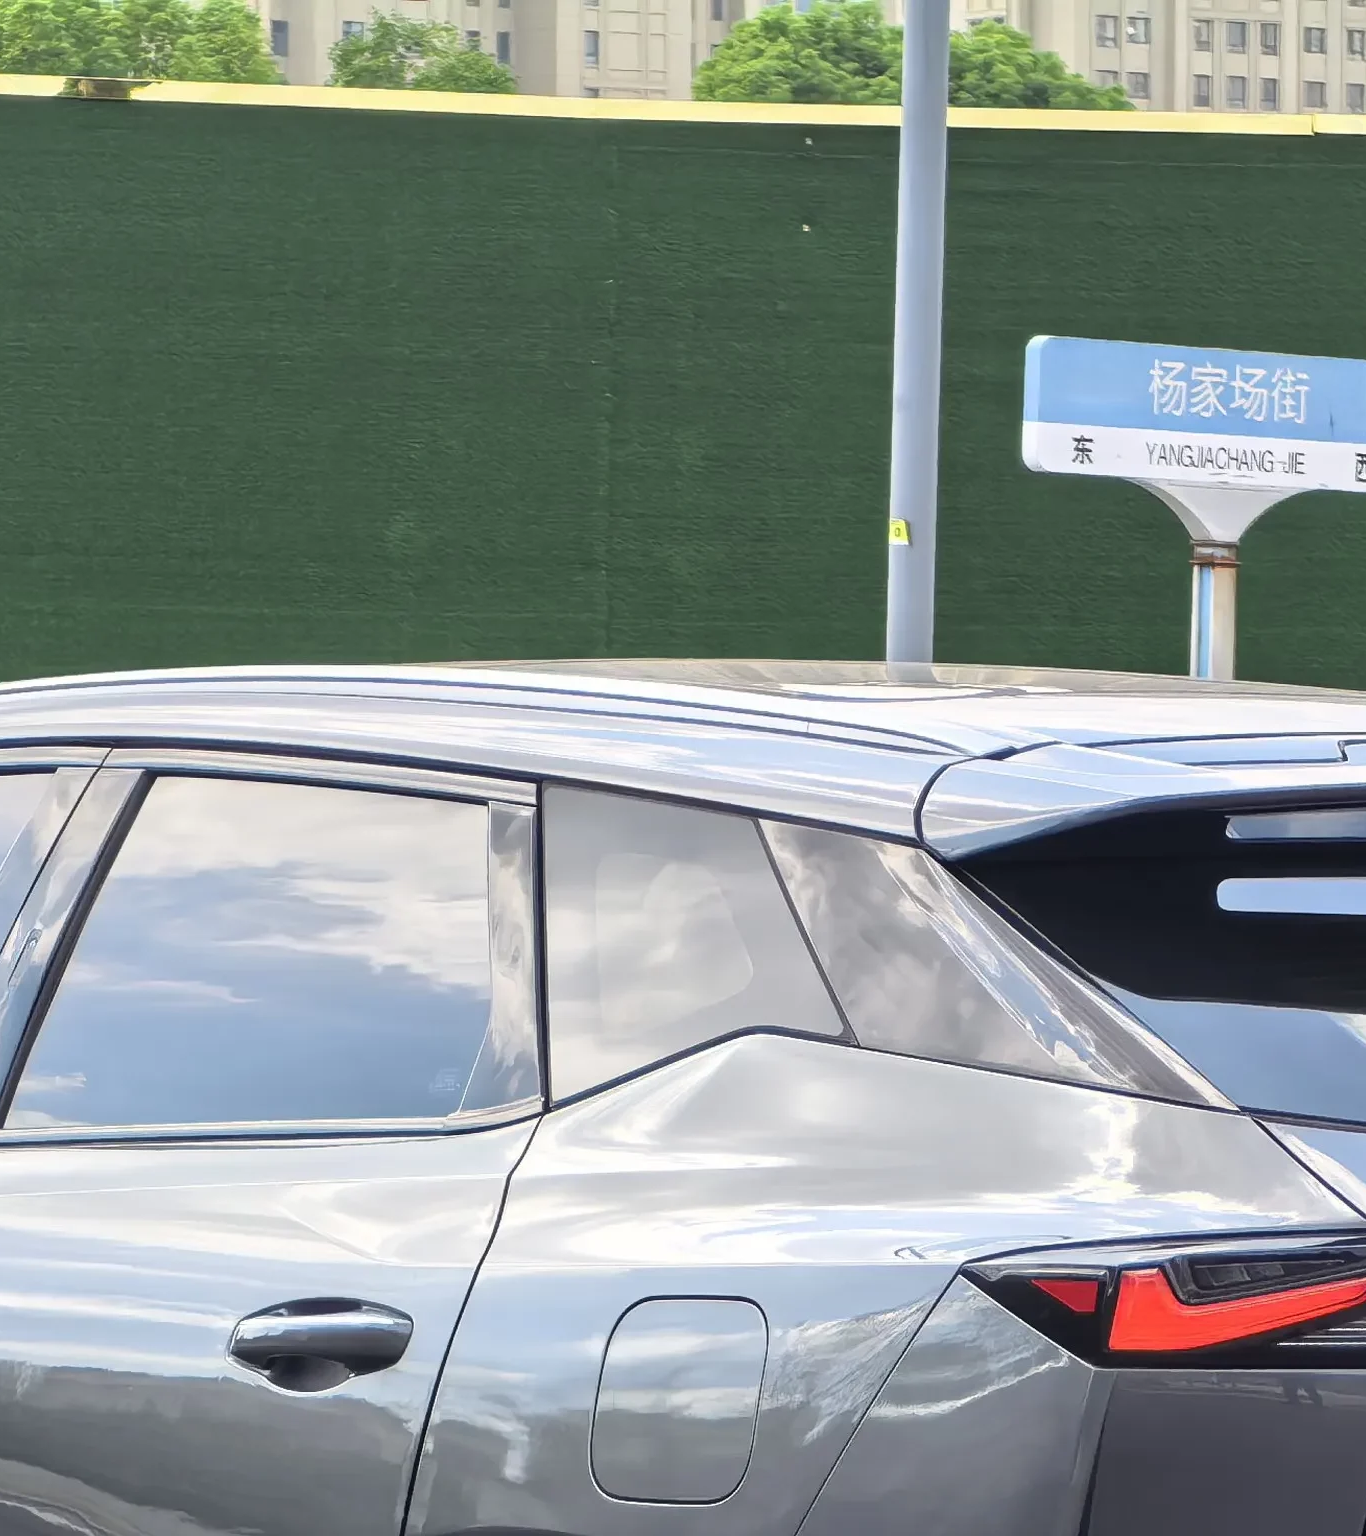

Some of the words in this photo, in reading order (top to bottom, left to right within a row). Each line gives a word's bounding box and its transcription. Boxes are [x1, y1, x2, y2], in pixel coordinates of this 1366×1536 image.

[1148, 358, 1311, 425] 杨家场街
[1071, 434, 1095, 465] 东
[1145, 441, 1275, 473] YANGJIACHANG
